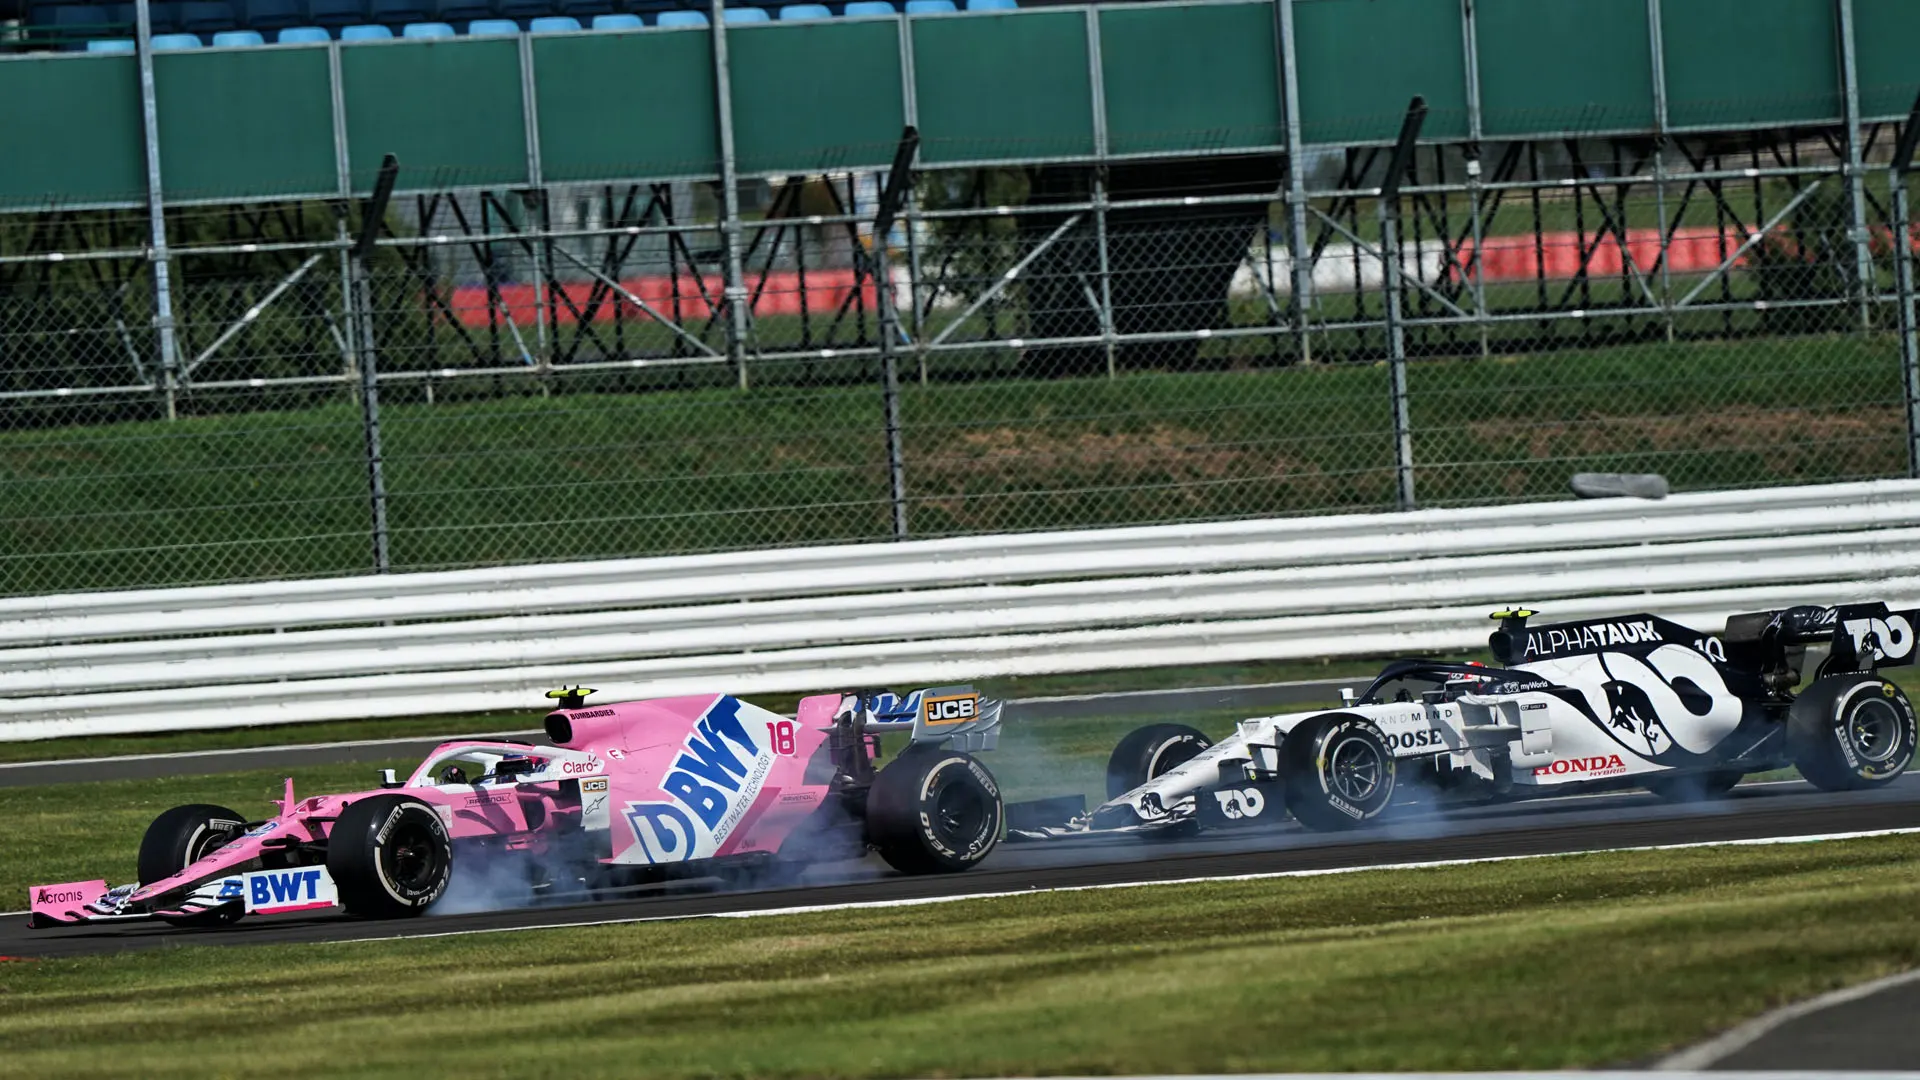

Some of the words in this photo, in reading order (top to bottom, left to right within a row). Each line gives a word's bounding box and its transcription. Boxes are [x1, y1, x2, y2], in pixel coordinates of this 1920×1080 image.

[1695, 636, 1727, 663] 10
[1520, 681, 1548, 691] myWorld
[569, 709, 616, 721] BOMBARDIER
[928, 699, 975, 721] JCB
[1411, 709, 1453, 722] MIND
[766, 721, 795, 756] 18
[1355, 721, 1393, 756] ZERO
[562, 761, 594, 774] Claro
[663, 694, 760, 833] BWT
[1532, 754, 1625, 776] HONDA
[1589, 767, 1627, 777] HYBRID
[584, 781, 606, 790] JCB
[713, 819, 732, 845] BEST
[728, 794, 751, 824] WATER
[744, 752, 772, 798] TECHNOLOGY
[210, 818, 242, 831] PIRE
[36, 889, 83, 905] Acronis
[250, 870, 321, 905] BWT
